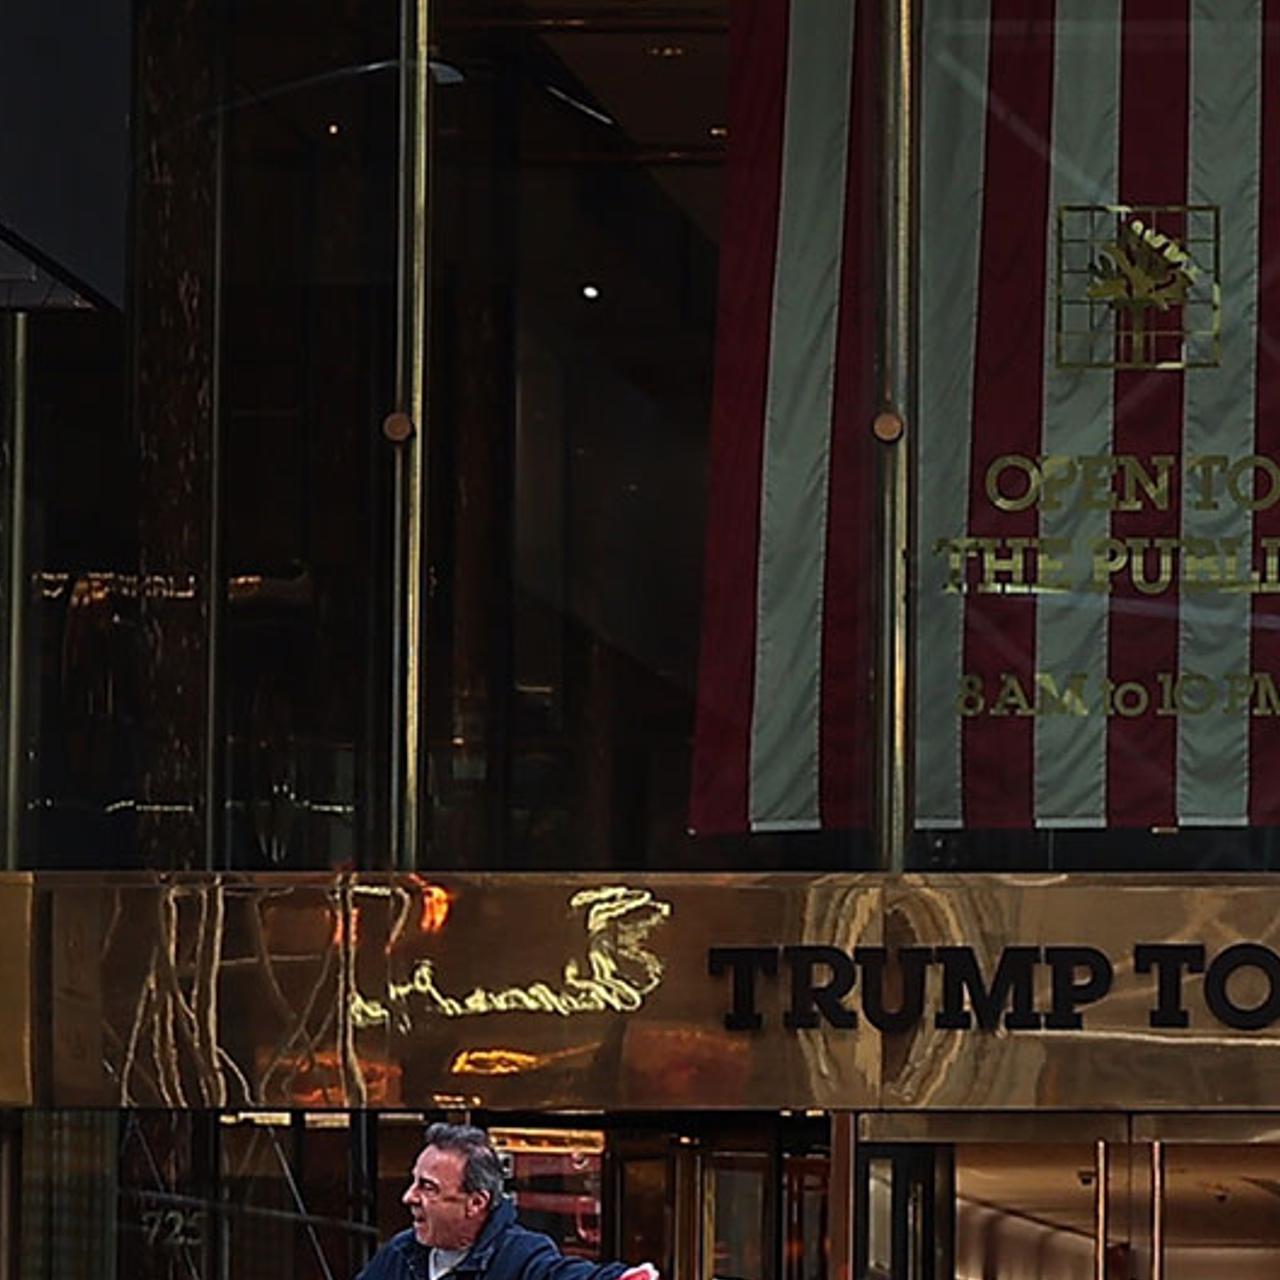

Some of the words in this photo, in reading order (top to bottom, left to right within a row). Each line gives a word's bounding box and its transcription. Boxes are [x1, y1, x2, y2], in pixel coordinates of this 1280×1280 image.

[985, 455, 1175, 511] OPEN
[932, 537, 1073, 594] THE
[957, 673, 984, 716] 8
[990, 673, 1088, 716] AM
[1157, 672, 1218, 716] 10
[708, 945, 1113, 1033] TRUMP
